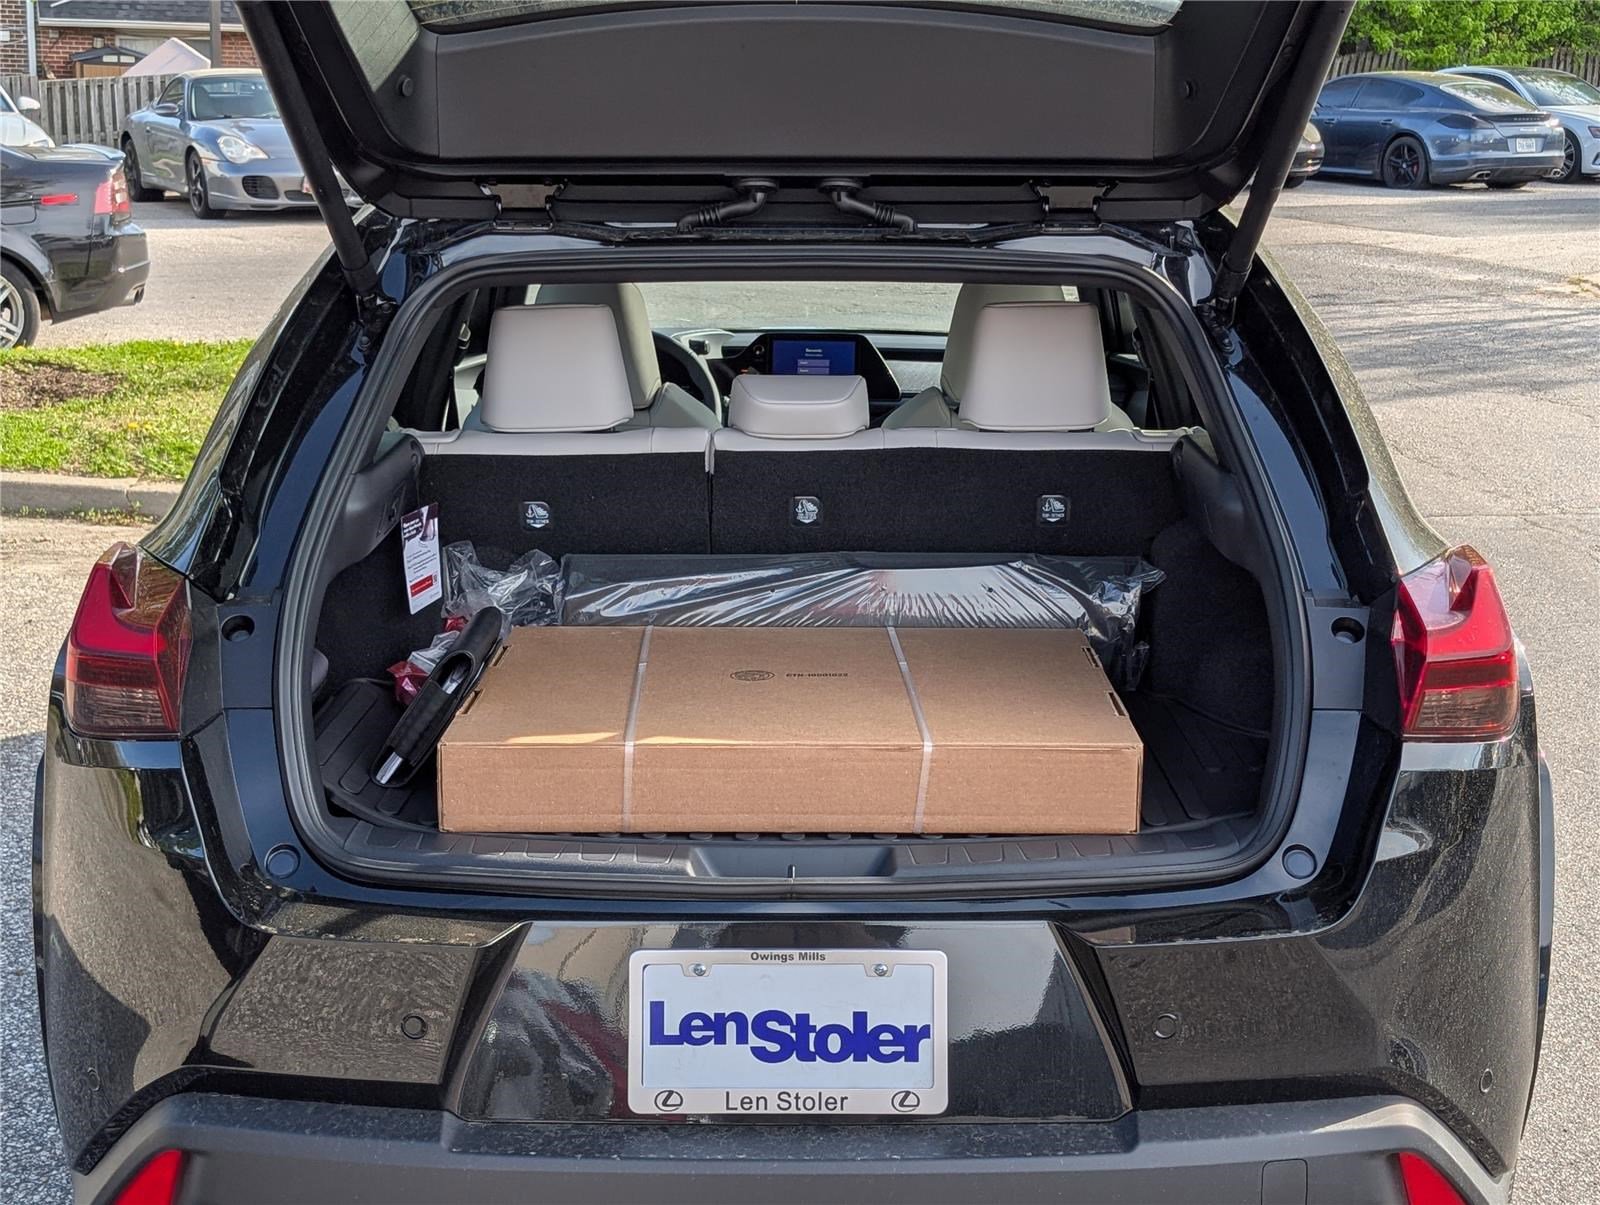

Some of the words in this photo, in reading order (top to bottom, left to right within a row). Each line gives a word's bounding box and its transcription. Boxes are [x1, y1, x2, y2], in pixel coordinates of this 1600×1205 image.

[750, 951, 795, 962] Owings
[798, 951, 826, 961] Mills
[650, 1001, 749, 1046] Len
[750, 1009, 931, 1063] Stoler
[725, 1091, 768, 1111] Len
[776, 1091, 849, 1112] Stoler
